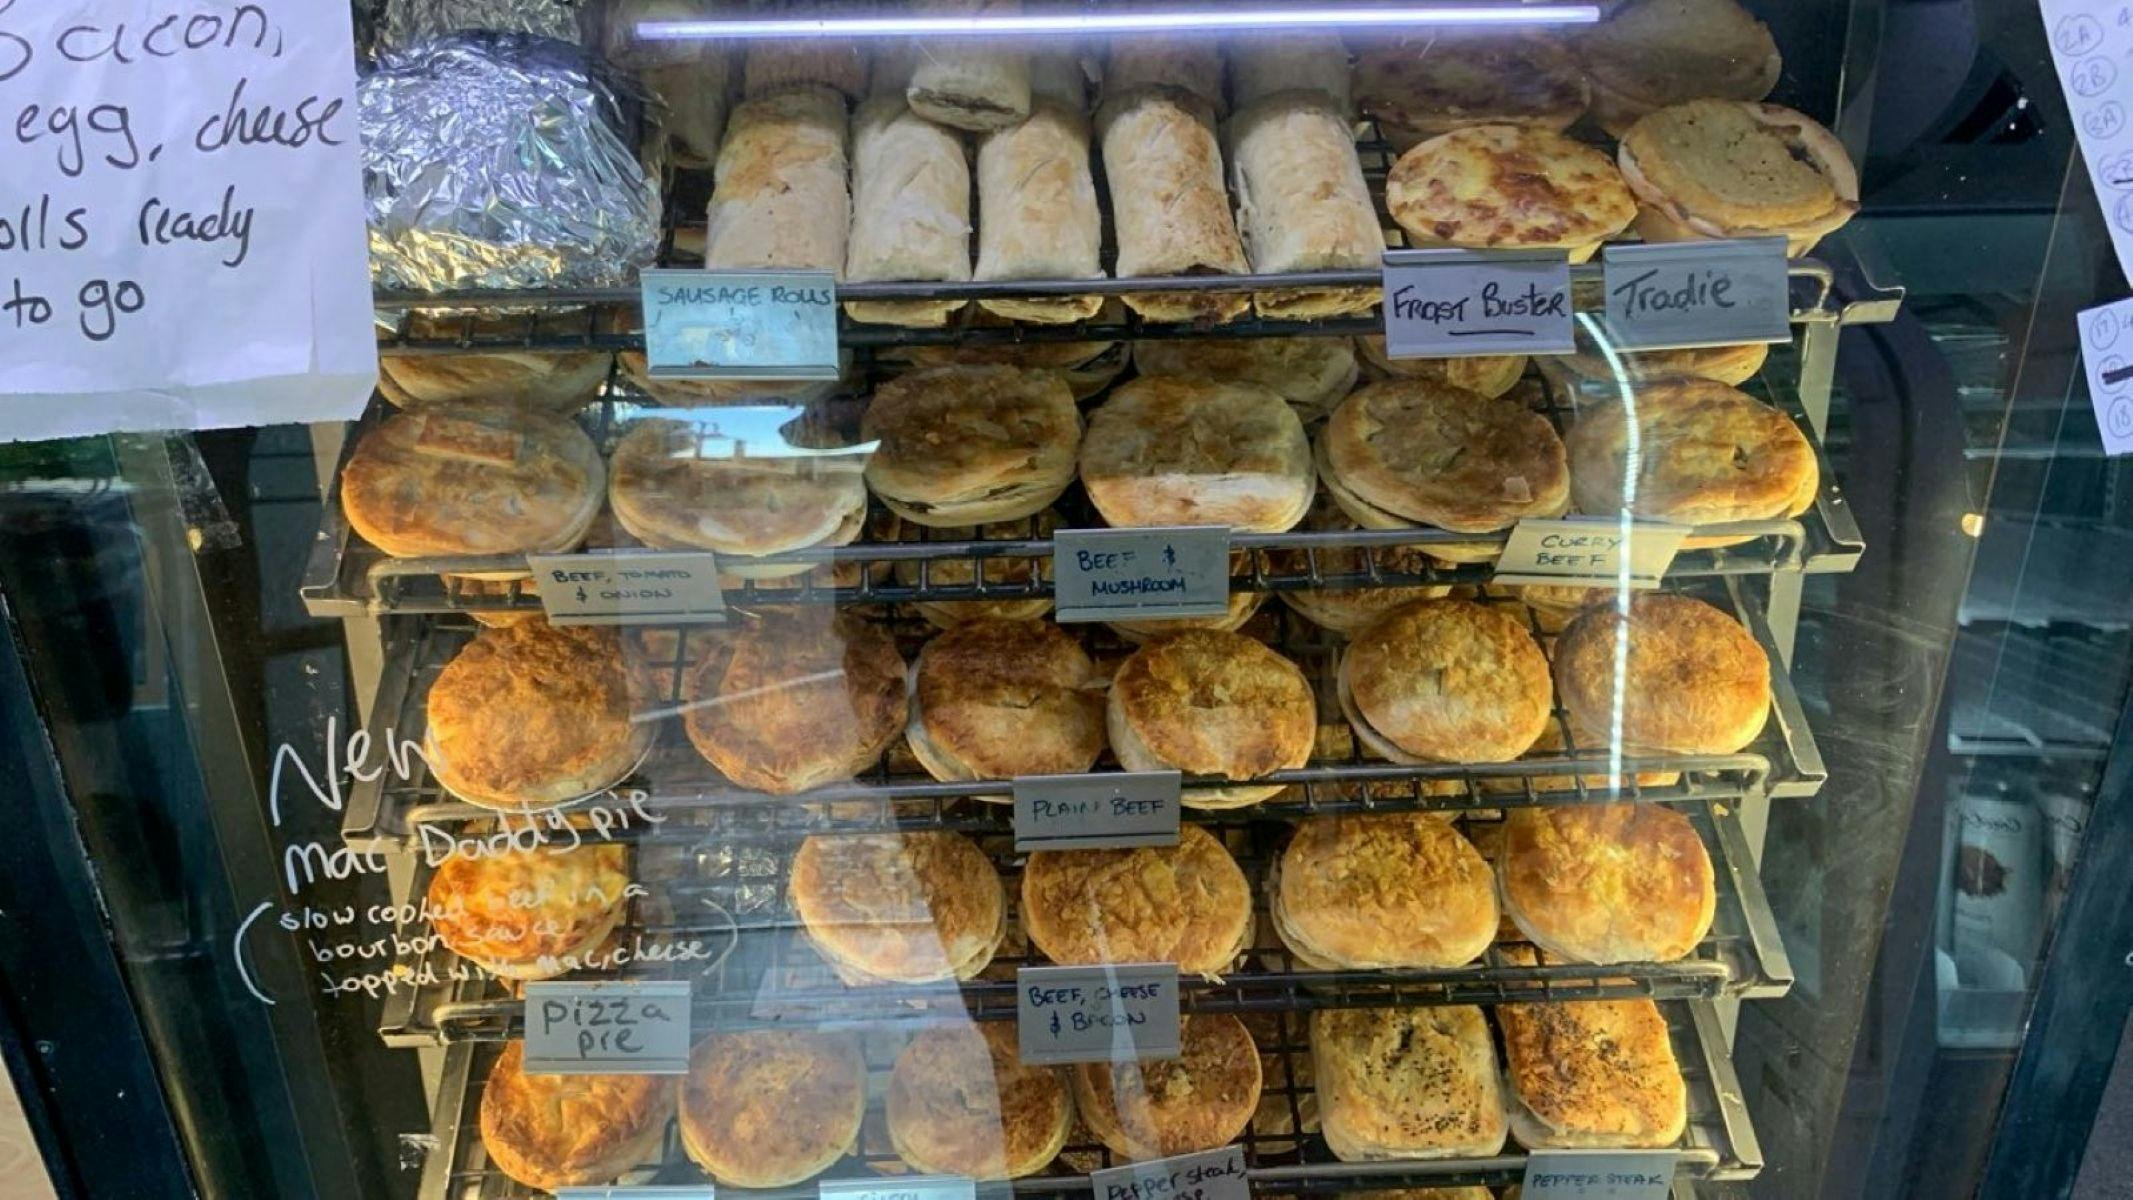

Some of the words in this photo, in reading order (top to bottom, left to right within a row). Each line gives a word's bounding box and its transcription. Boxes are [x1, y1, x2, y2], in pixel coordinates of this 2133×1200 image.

[16, 104, 163, 177] egg,
[195, 77, 346, 153] cheese
[138, 184, 255, 268] ready
[657, 286, 763, 307] SAUSAGE
[1613, 268, 1736, 320] Tradie
[2, 277, 53, 328] to
[78, 279, 146, 342] go
[1541, 534, 1622, 550] CURRY
[1536, 552, 1606, 567] BEEF
[551, 569, 612, 584] BEEF,
[618, 568, 691, 581] TOMATO
[1092, 577, 1186, 596] MUSHROOM
[599, 588, 672, 599] ONION
[588, 789, 667, 841] pie
[1032, 800, 1099, 824] PLAIN
[1110, 797, 1164, 816] BEEF
[280, 906, 355, 931] slow
[308, 933, 447, 963] bourbon
[1028, 986, 1086, 1008] BEEF,
[543, 998, 671, 1035] pizza
[1072, 1012, 1147, 1031] BACON
[1606, 1173, 1664, 1186] STEAK
